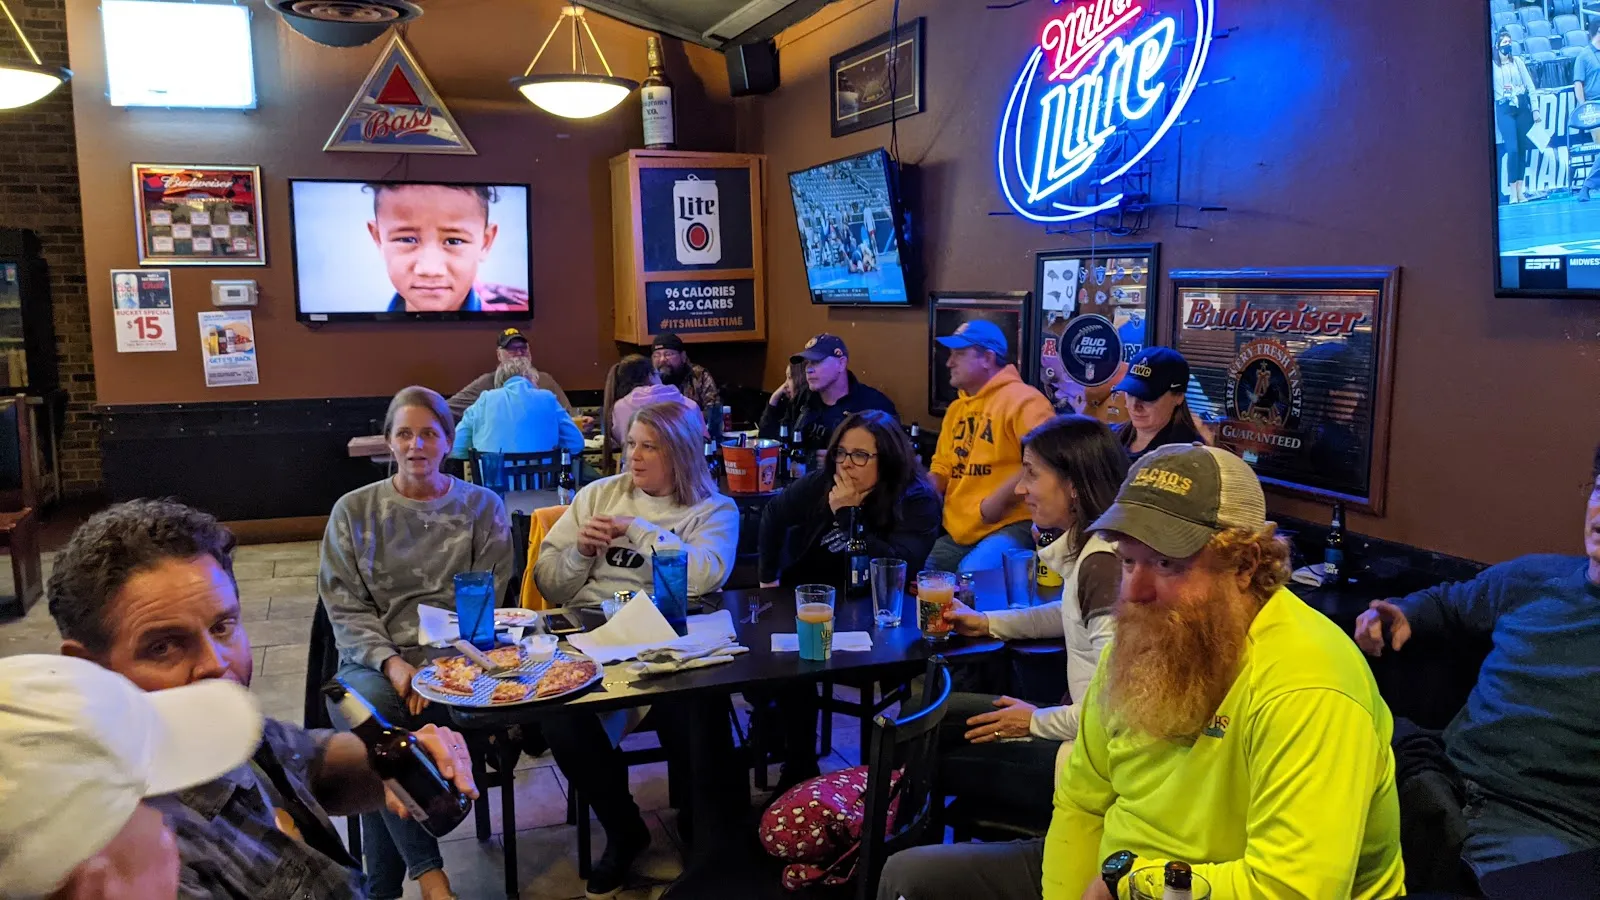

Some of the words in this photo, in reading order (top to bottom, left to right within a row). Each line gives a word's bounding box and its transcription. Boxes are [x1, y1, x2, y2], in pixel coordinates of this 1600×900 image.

[1028, 17, 1175, 203] Lite
[364, 107, 432, 140] Bass
[161, 176, 233, 188] Budweiser
[678, 196, 716, 221] Lite
[1525, 258, 1561, 270] ESPN
[1570, 257, 1600, 266] MIDWES
[665, 287, 680, 299] 96
[682, 285, 736, 298] CALORIES
[668, 300, 694, 312] 3.2G
[696, 298, 734, 310] CARBS
[660, 316, 743, 330] #ITSMILLERTIME
[1184, 298, 1366, 336] Budweiser
[126, 316, 163, 340] $15
[1074, 344, 1108, 356] LIGHT
[1080, 336, 1106, 347] BUD
[1256, 343, 1291, 369] FRESH
[1287, 366, 1303, 419] TASTE
[1221, 424, 1302, 449] GUARANTEED
[611, 548, 637, 568] 47
